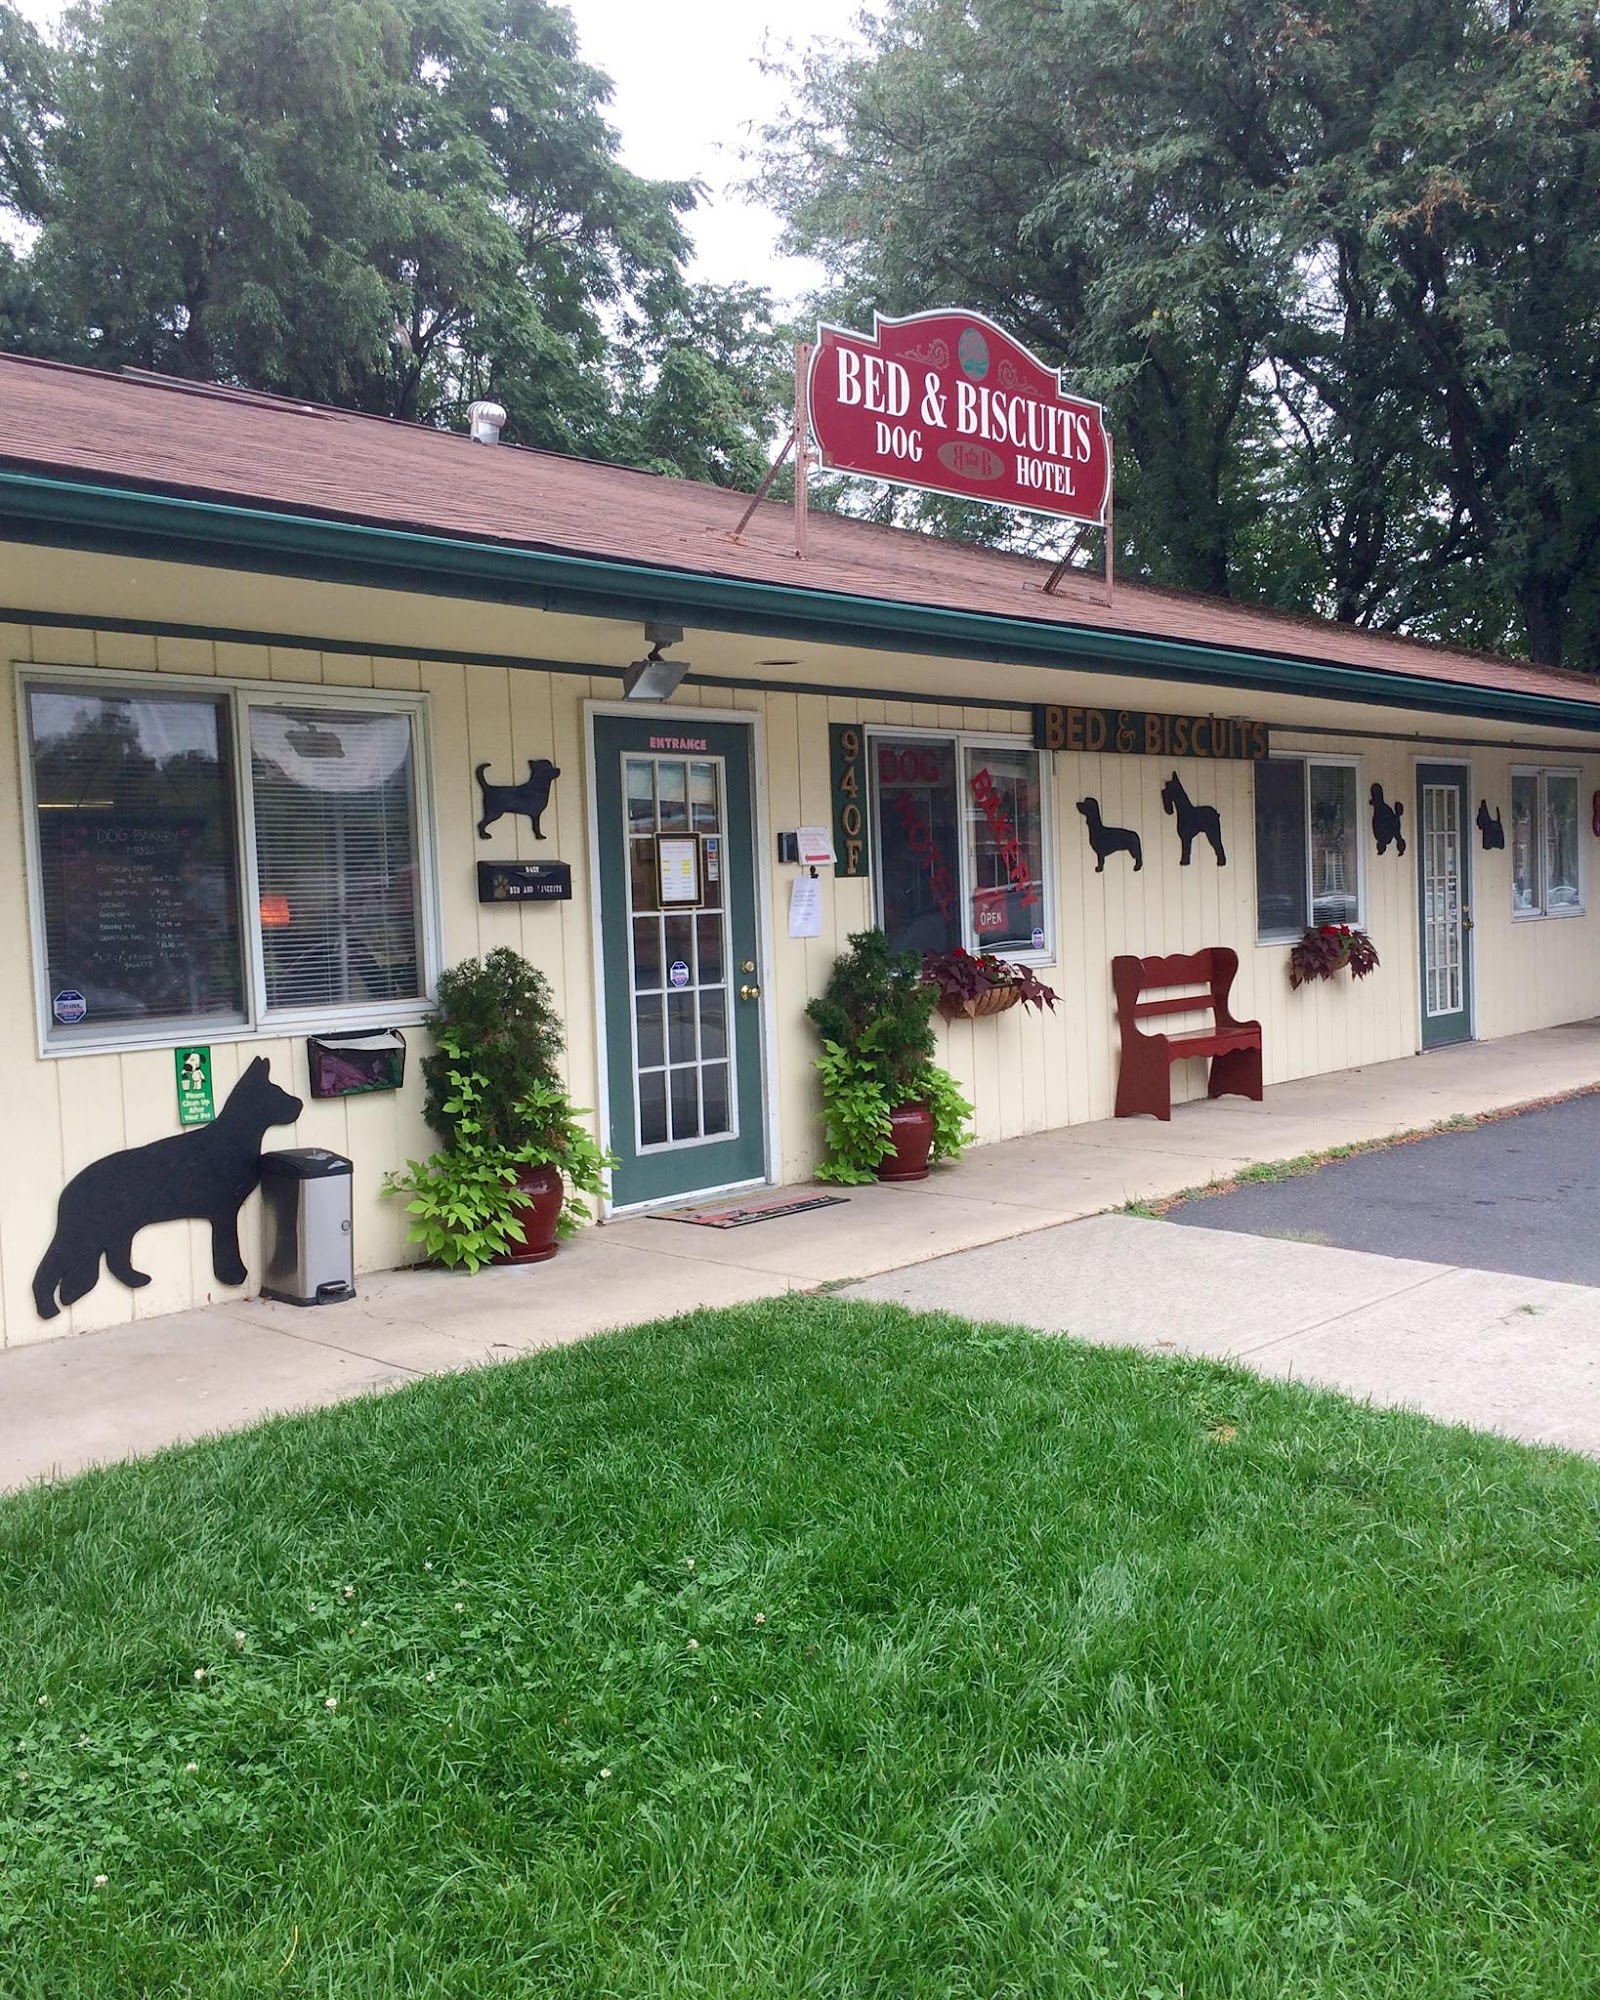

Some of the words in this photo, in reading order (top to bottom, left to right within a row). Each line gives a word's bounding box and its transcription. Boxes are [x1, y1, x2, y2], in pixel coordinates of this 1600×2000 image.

[836, 346, 911, 418] BED
[921, 372, 948, 429] &
[955, 379, 1092, 464] BISCUITS
[875, 421, 923, 463] DOG
[1015, 454, 1076, 497] HOTEL
[649, 736, 707, 751] ENTRANCE
[1045, 706, 1108, 751] BED
[1115, 710, 1137, 753] &
[1143, 713, 1268, 760] BISCUITS
[877, 748, 940, 784] DOG
[840, 729, 863, 875] 940F
[970, 767, 1041, 910] BAKERY
[979, 911, 1002, 926] OPEN
